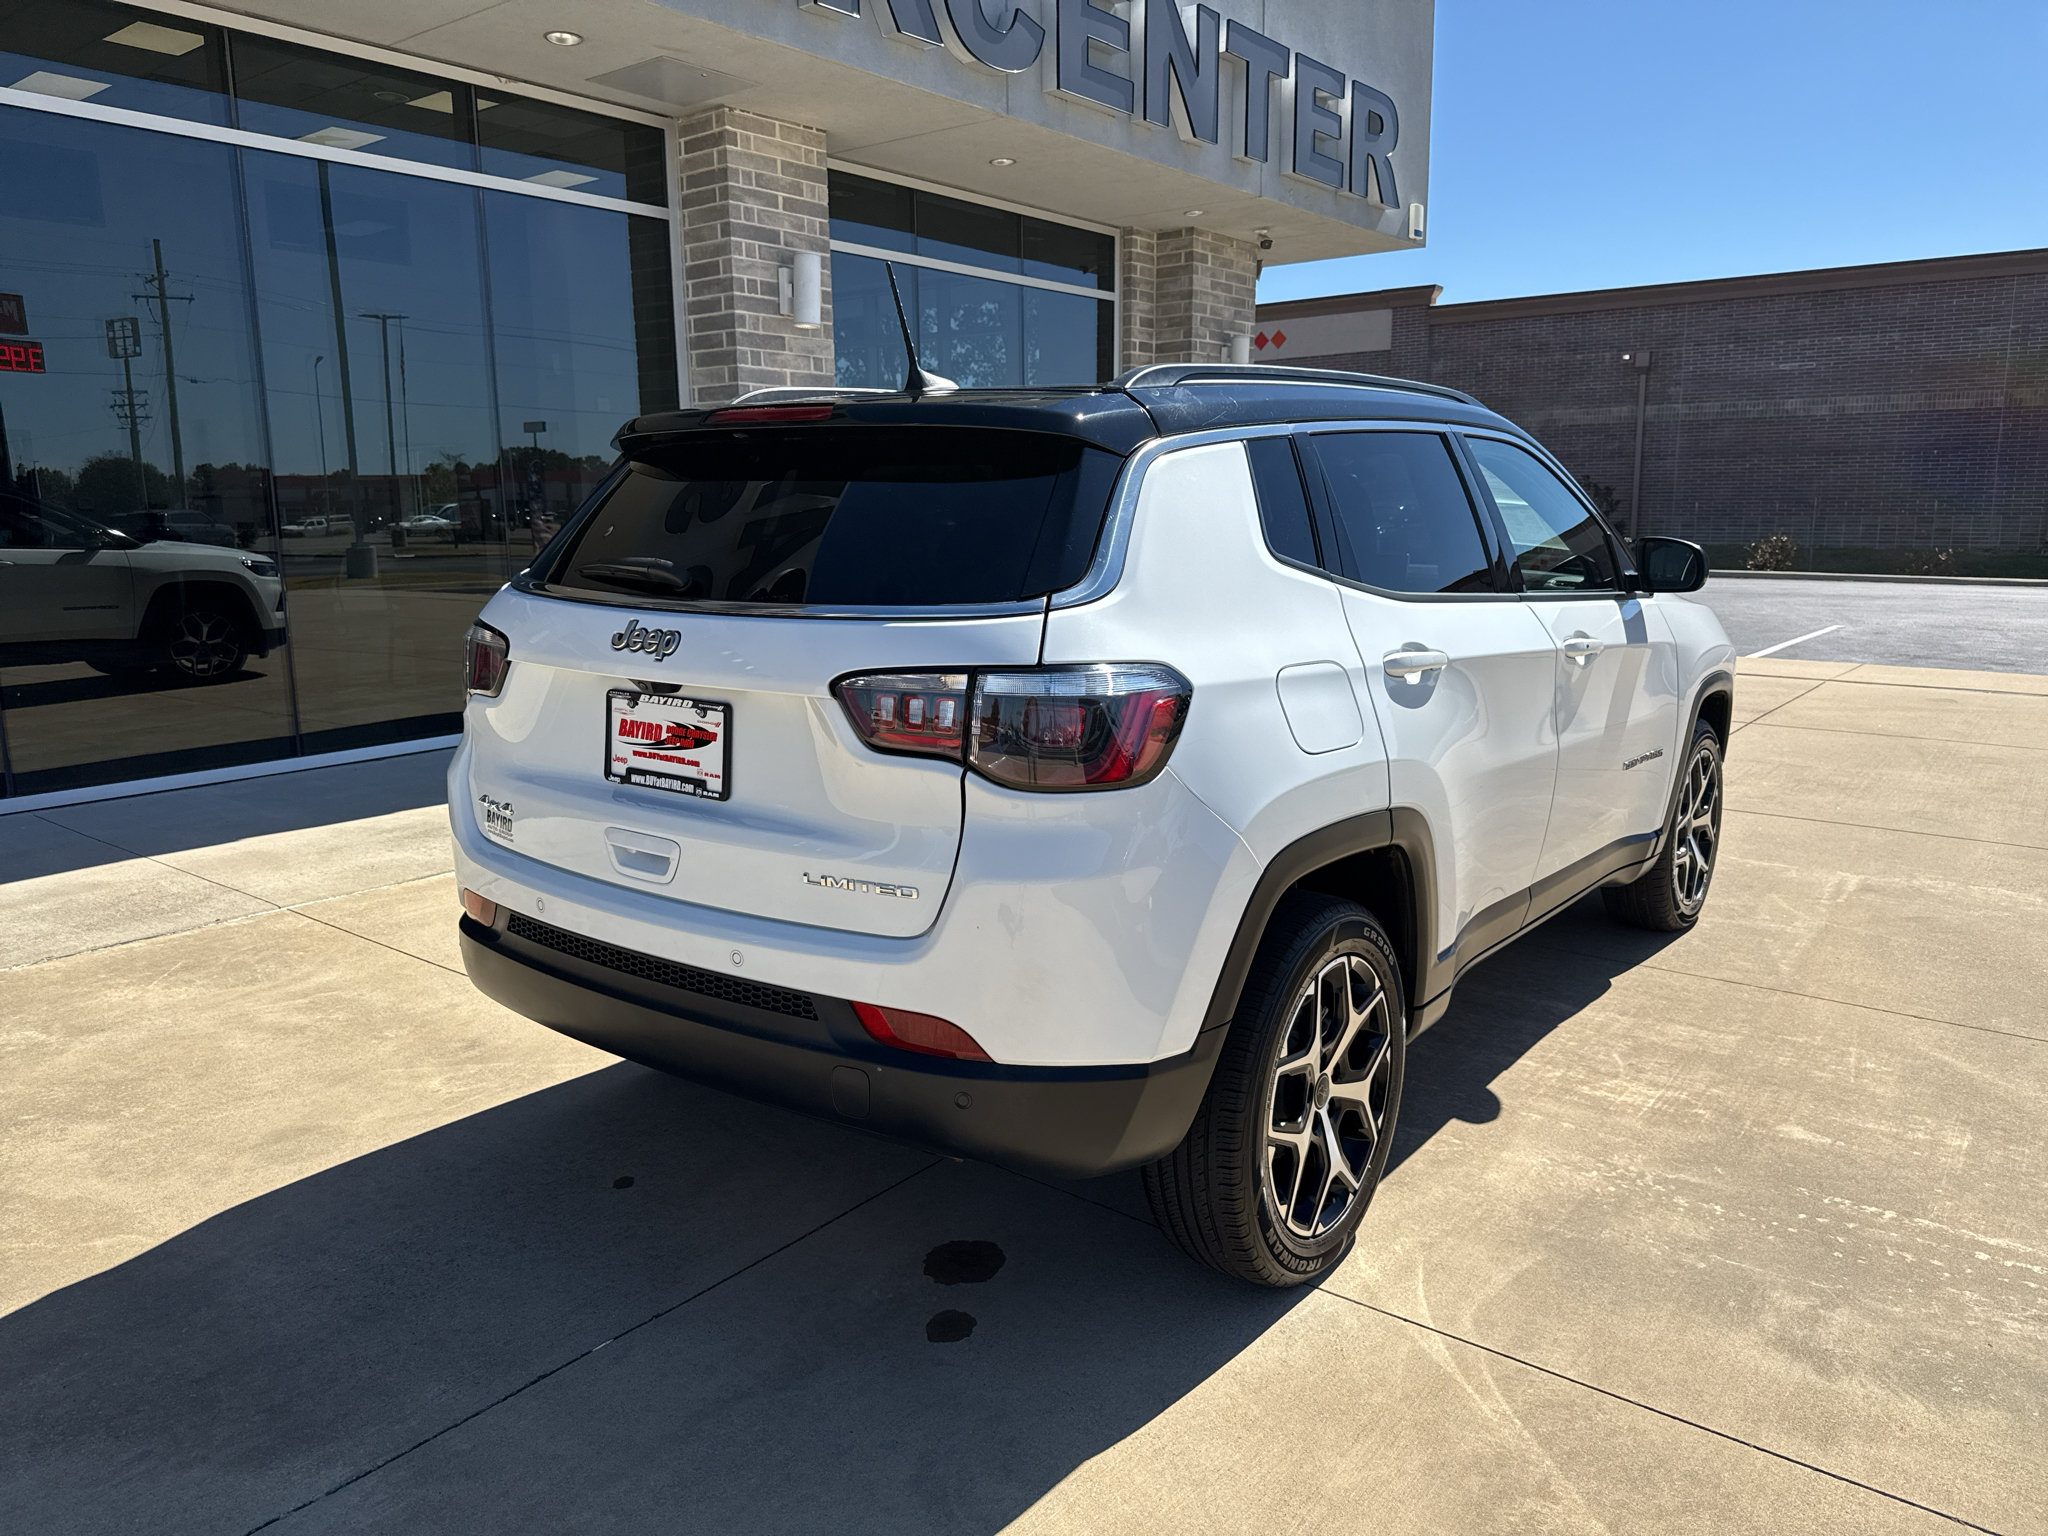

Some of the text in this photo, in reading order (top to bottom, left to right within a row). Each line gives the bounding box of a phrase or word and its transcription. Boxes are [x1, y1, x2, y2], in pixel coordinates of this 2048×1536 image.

[800, 0, 1399, 209] ENTER
[611, 618, 681, 661] Jeep
[639, 694, 694, 708] BAYIRD
[618, 718, 663, 742] BAYIRD
[487, 809, 513, 832] BAYIRD
[803, 872, 919, 899] LIMITED
[1265, 1226, 1323, 1272] IRONMAN
